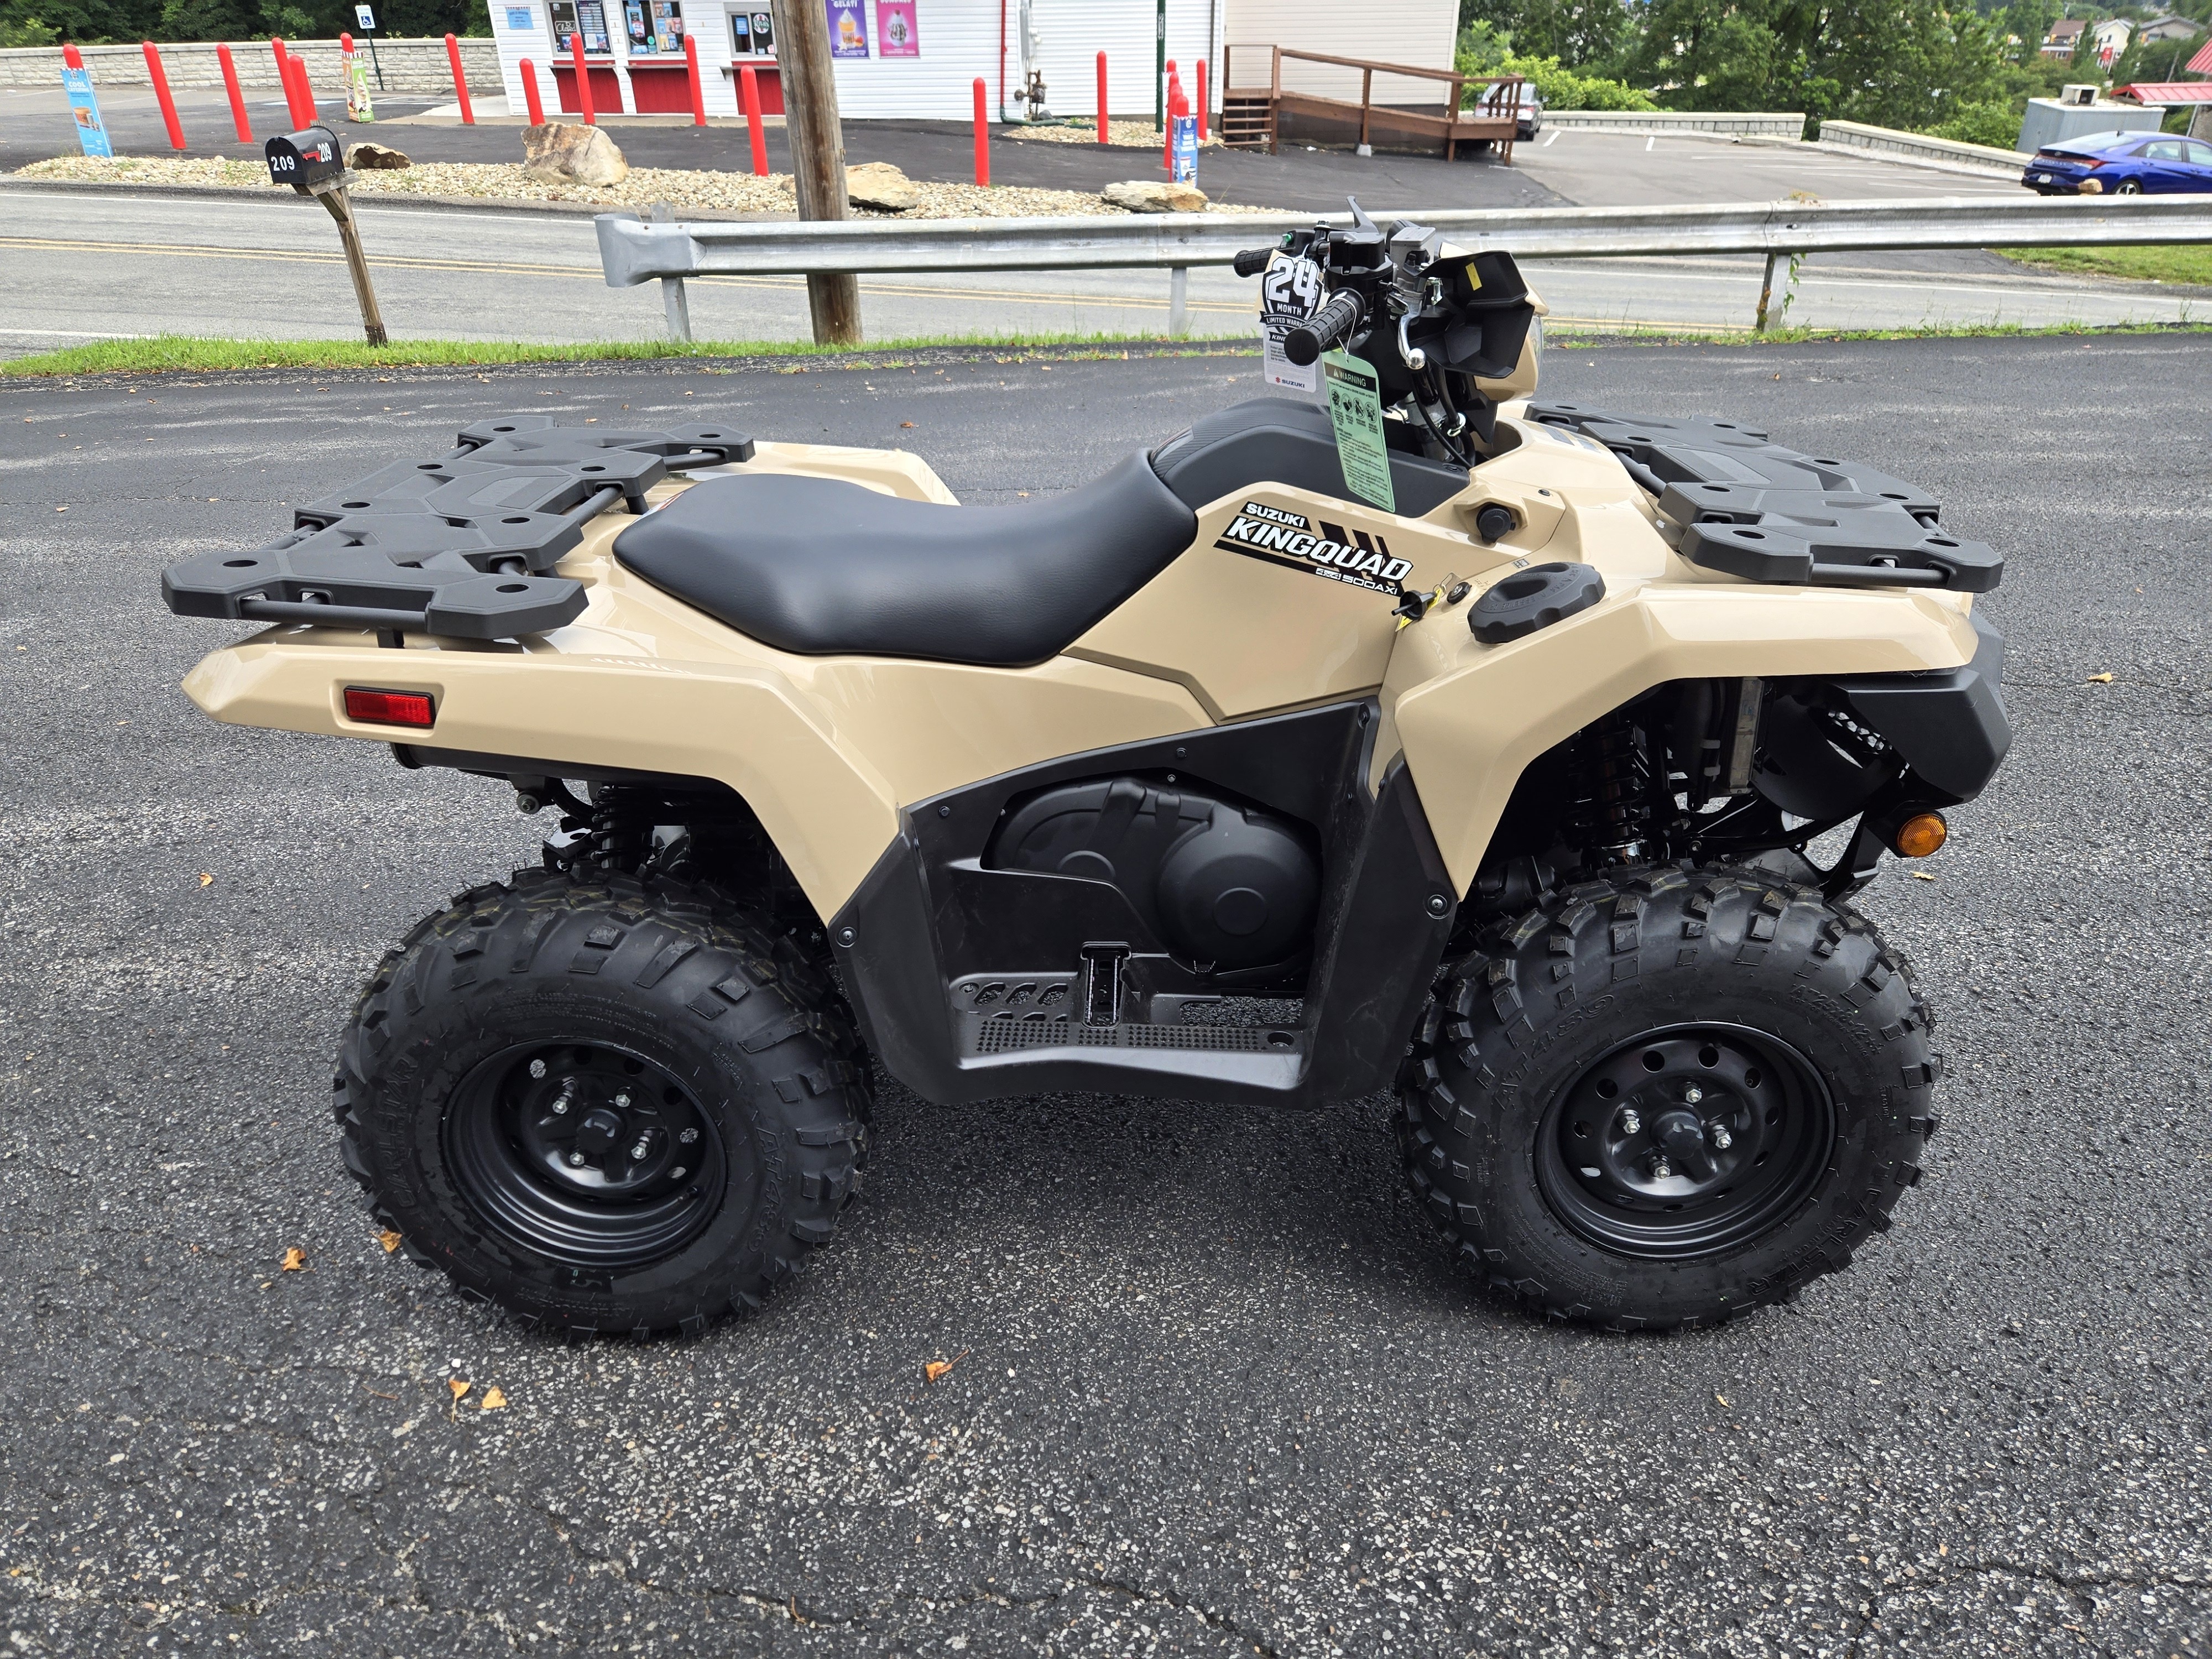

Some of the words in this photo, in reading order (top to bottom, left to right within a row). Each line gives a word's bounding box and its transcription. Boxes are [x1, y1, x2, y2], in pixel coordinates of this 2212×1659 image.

[270, 155, 295, 171] 209
[317, 142, 332, 163] 209
[1267, 256, 1317, 309] 24
[1277, 303, 1302, 316] MONTH
[1286, 318, 1306, 327] WARRA
[1282, 379, 1305, 388] SUZUKI
[1339, 371, 1366, 387] WARNING
[1246, 503, 1305, 528] SUZUKI
[1227, 517, 1412, 581] KINGQUAD
[1316, 568, 1341, 580] 4x4
[1494, 994, 1615, 1110] AT489
[377, 1056, 419, 1207] CARLSTAR
[747, 1126, 784, 1253] AT489
[1746, 1187, 1882, 1295] CARLSTAR
